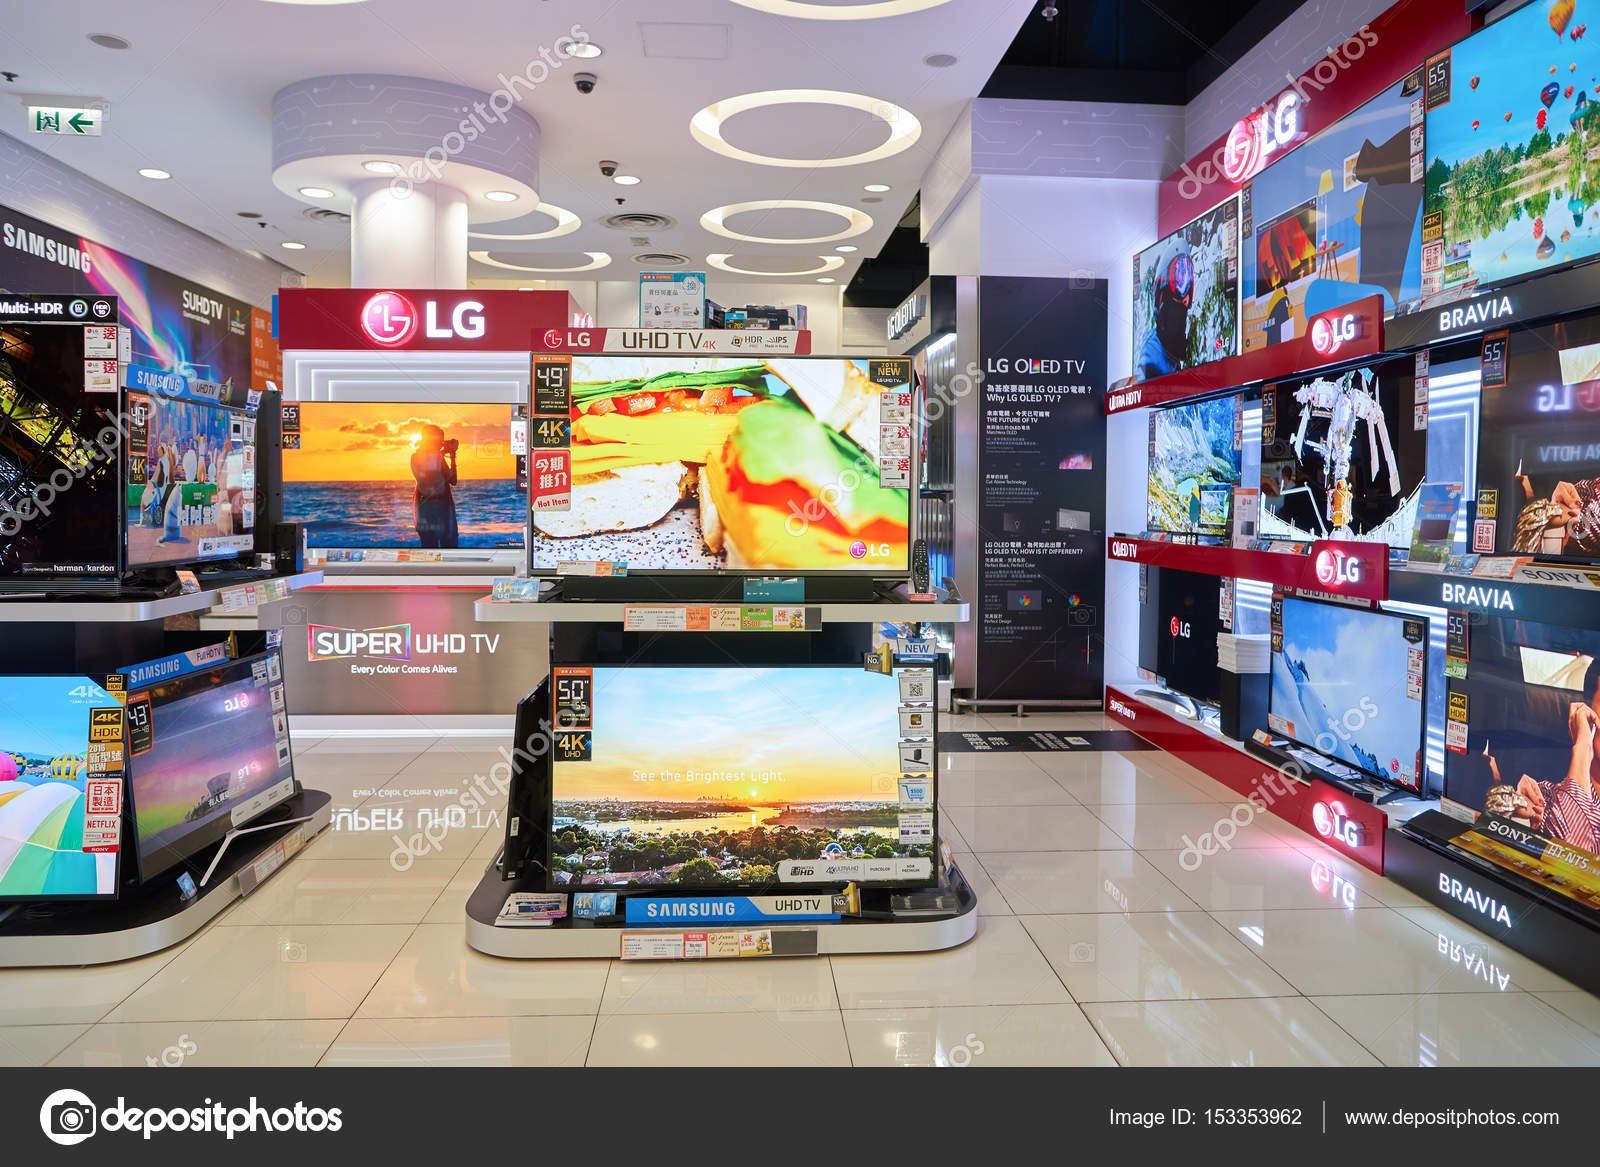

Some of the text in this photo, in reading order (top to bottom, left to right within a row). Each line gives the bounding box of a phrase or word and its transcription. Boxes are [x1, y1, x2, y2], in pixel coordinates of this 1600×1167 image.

[1261, 94, 1297, 156] LG
[1424, 216, 1439, 226] 4K
[1424, 228, 1441, 239] HDR
[3, 222, 91, 274] SAMSUNG
[0, 302, 63, 314] Multi-HDR
[1440, 296, 1513, 332] BRAVIA
[426, 301, 485, 338] LG
[1333, 314, 1354, 341] LG
[567, 332, 591, 347] LG
[622, 333, 669, 349] UHD
[672, 333, 703, 349] TV
[744, 335, 763, 344] HDR
[878, 368, 901, 376] NEW
[987, 358, 1086, 374] LG OLED TV
[137, 370, 181, 391] SAMSUNG
[1034, 385, 1045, 393] LG
[987, 394, 1003, 403] Why
[1007, 394, 1018, 402] LG
[1020, 394, 1042, 402] OLED
[537, 420, 564, 437] 4K
[131, 459, 145, 474] 4K
[536, 456, 563, 473] 今期
[539, 473, 567, 489] 推介
[537, 499, 551, 508] Hot
[1480, 493, 1495, 502] 4K
[1478, 505, 1495, 514] HDR
[870, 544, 890, 557] LG
[1112, 542, 1137, 558] OLED TV
[54, 564, 83, 572] harman
[87, 564, 115, 572] kardon
[1337, 557, 1359, 582] LG
[1522, 569, 1584, 584] SONY
[494, 581, 513, 592] 4K
[1442, 583, 1514, 610] BRAVIA
[1180, 621, 1190, 638] LG
[317, 632, 500, 655] SUPER UHD TV
[1272, 635, 1281, 646] 4K
[905, 644, 930, 654] NEW
[867, 656, 880, 665] No.
[131, 659, 180, 683] SAMSUNG
[351, 664, 458, 675] Every Color Comes Alives
[68, 685, 105, 698] 4K
[1451, 697, 1465, 706] 4K
[94, 713, 120, 722] 4K
[1450, 708, 1465, 719] HDR
[94, 728, 120, 737] HDR
[1449, 723, 1466, 733] NETFLIX
[558, 734, 585, 750] 4K
[89, 763, 106, 772] NEW
[632, 770, 656, 781] See
[660, 769, 681, 781] the
[686, 769, 745, 783] Brightest
[94, 786, 114, 796] 日本
[93, 797, 114, 807] 製造
[87, 820, 116, 829] NETFLIX
[1334, 814, 1358, 847] LG
[1488, 820, 1532, 845] SONY
[576, 897, 592, 909] 4K
[1439, 872, 1511, 928] BRAVIA
[647, 899, 821, 917] SAMSUNG UHD TV
